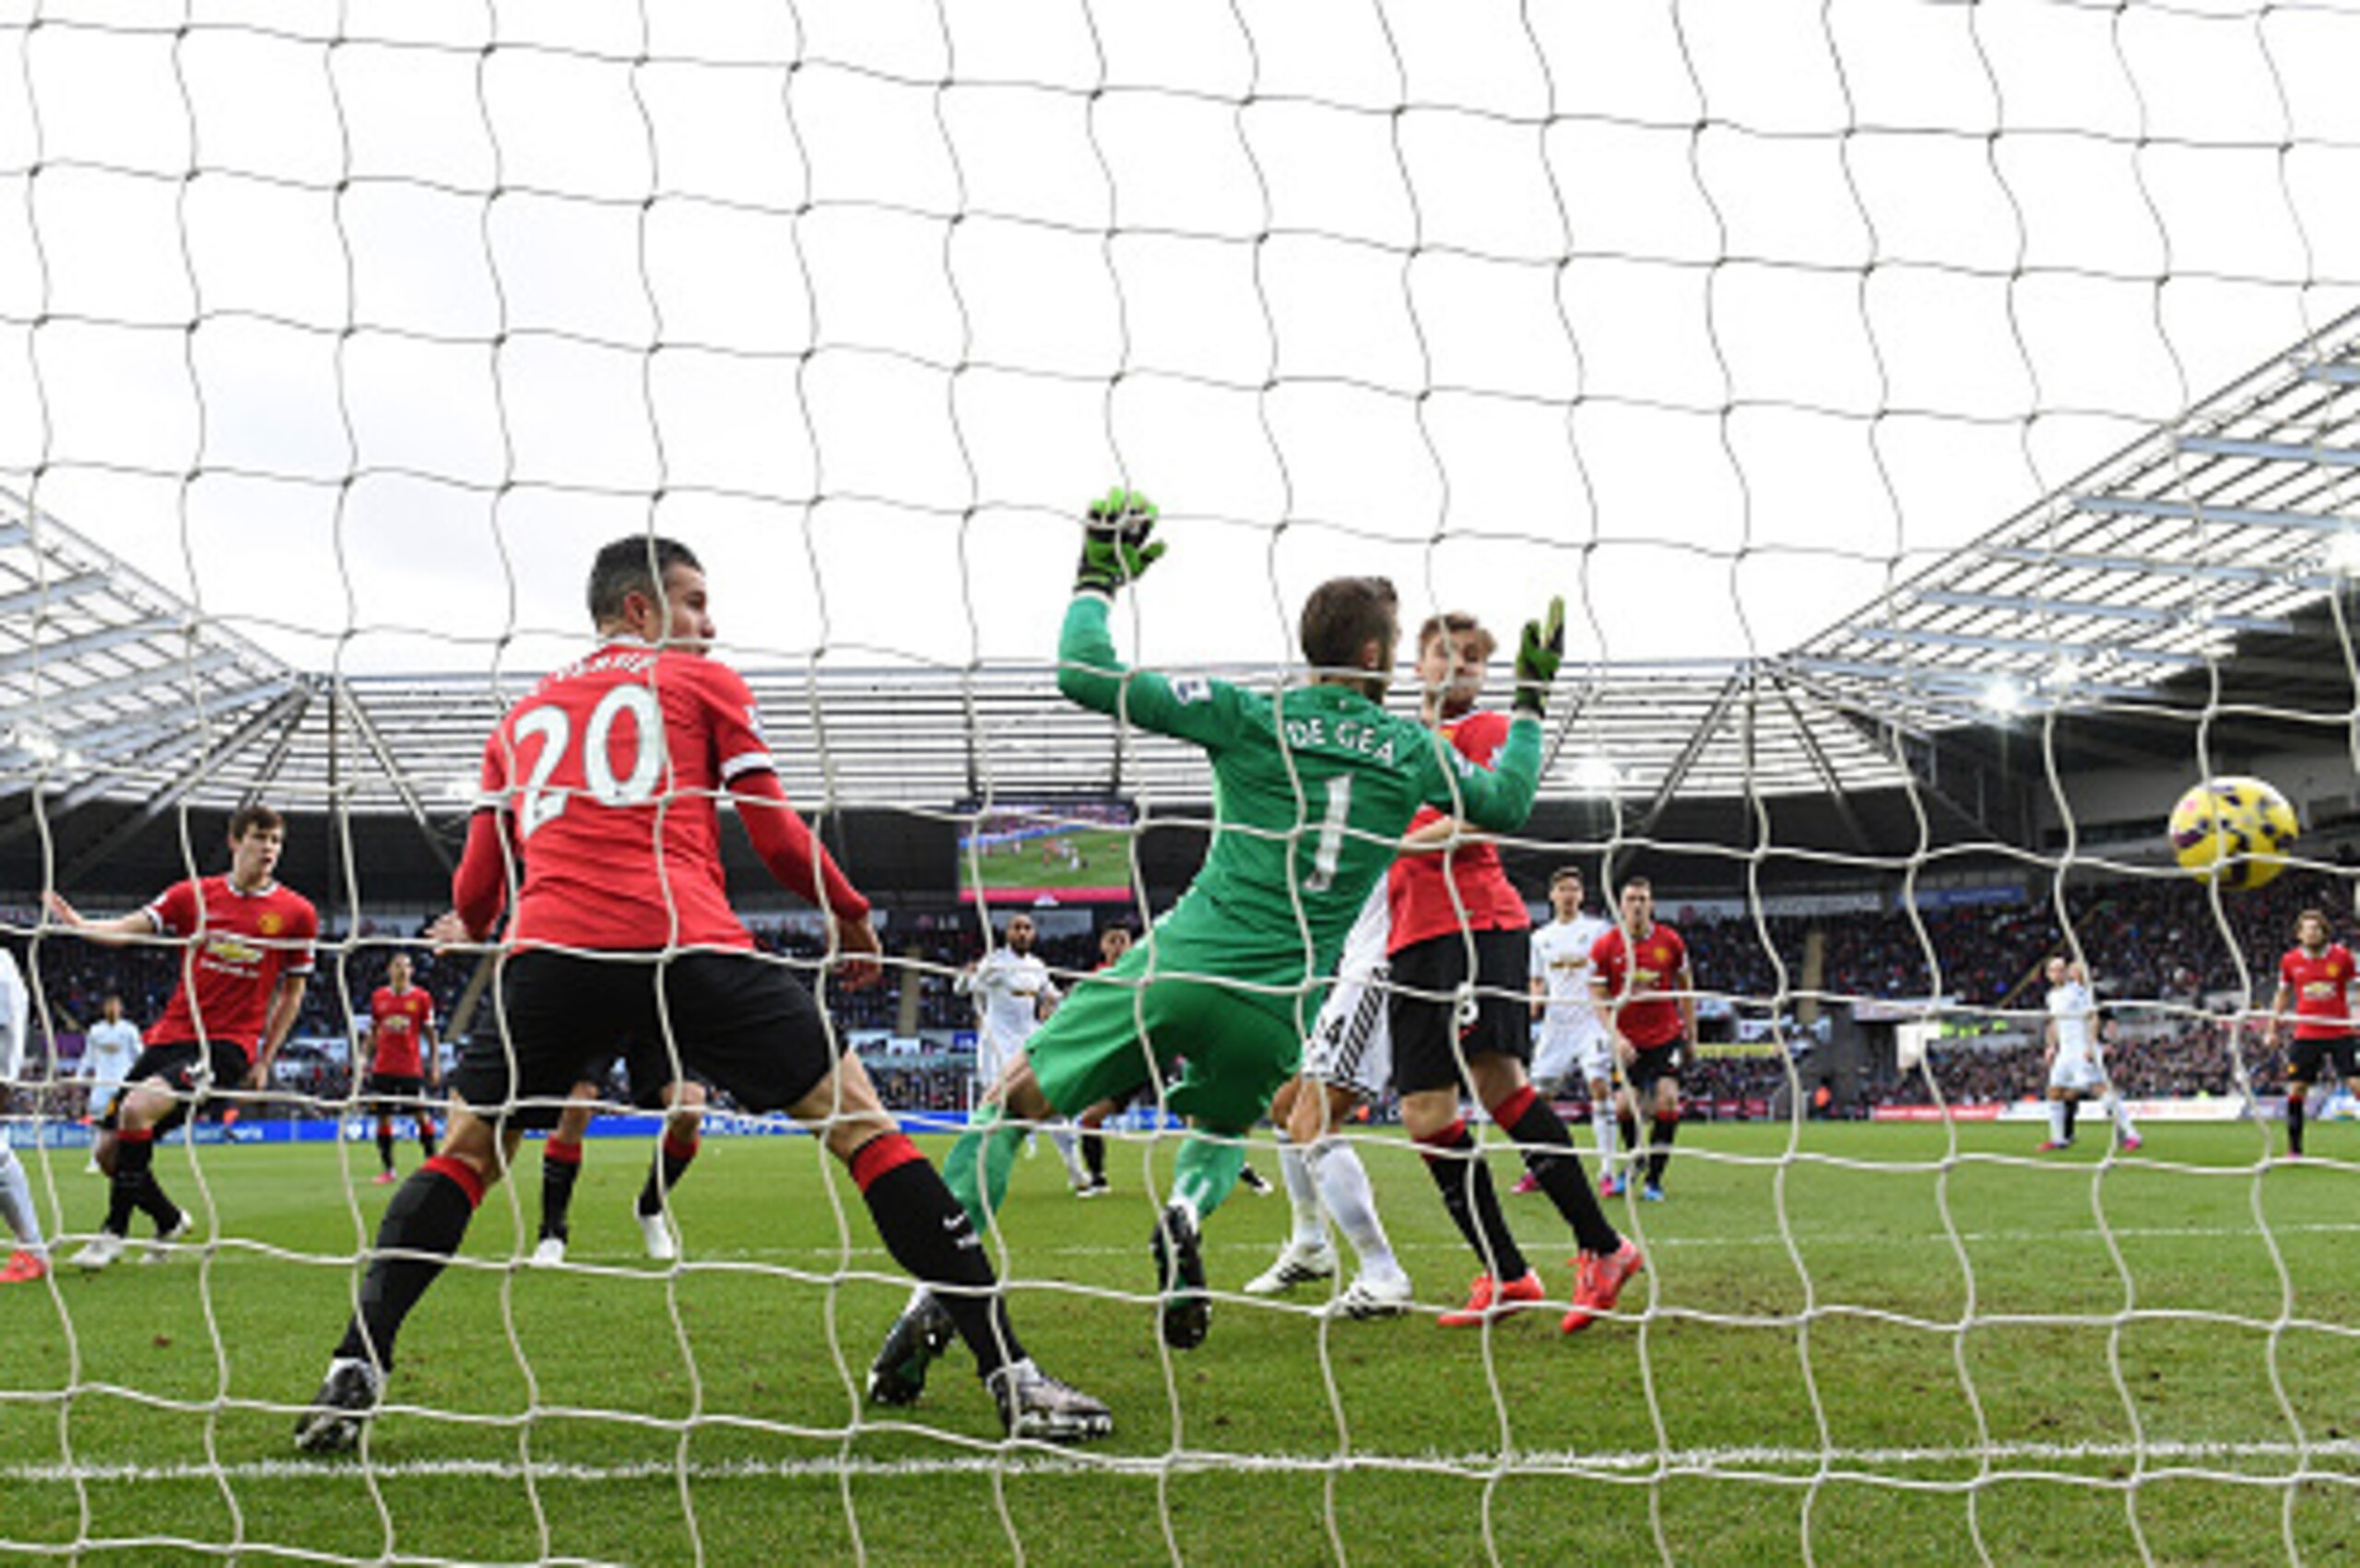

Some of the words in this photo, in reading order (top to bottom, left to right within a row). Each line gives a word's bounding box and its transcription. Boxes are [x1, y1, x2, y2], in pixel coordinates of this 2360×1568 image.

[514, 681, 662, 840] 20
[1287, 718, 1326, 749] DE
[1336, 721, 1394, 767] GEA
[1304, 772, 1353, 891] 1
